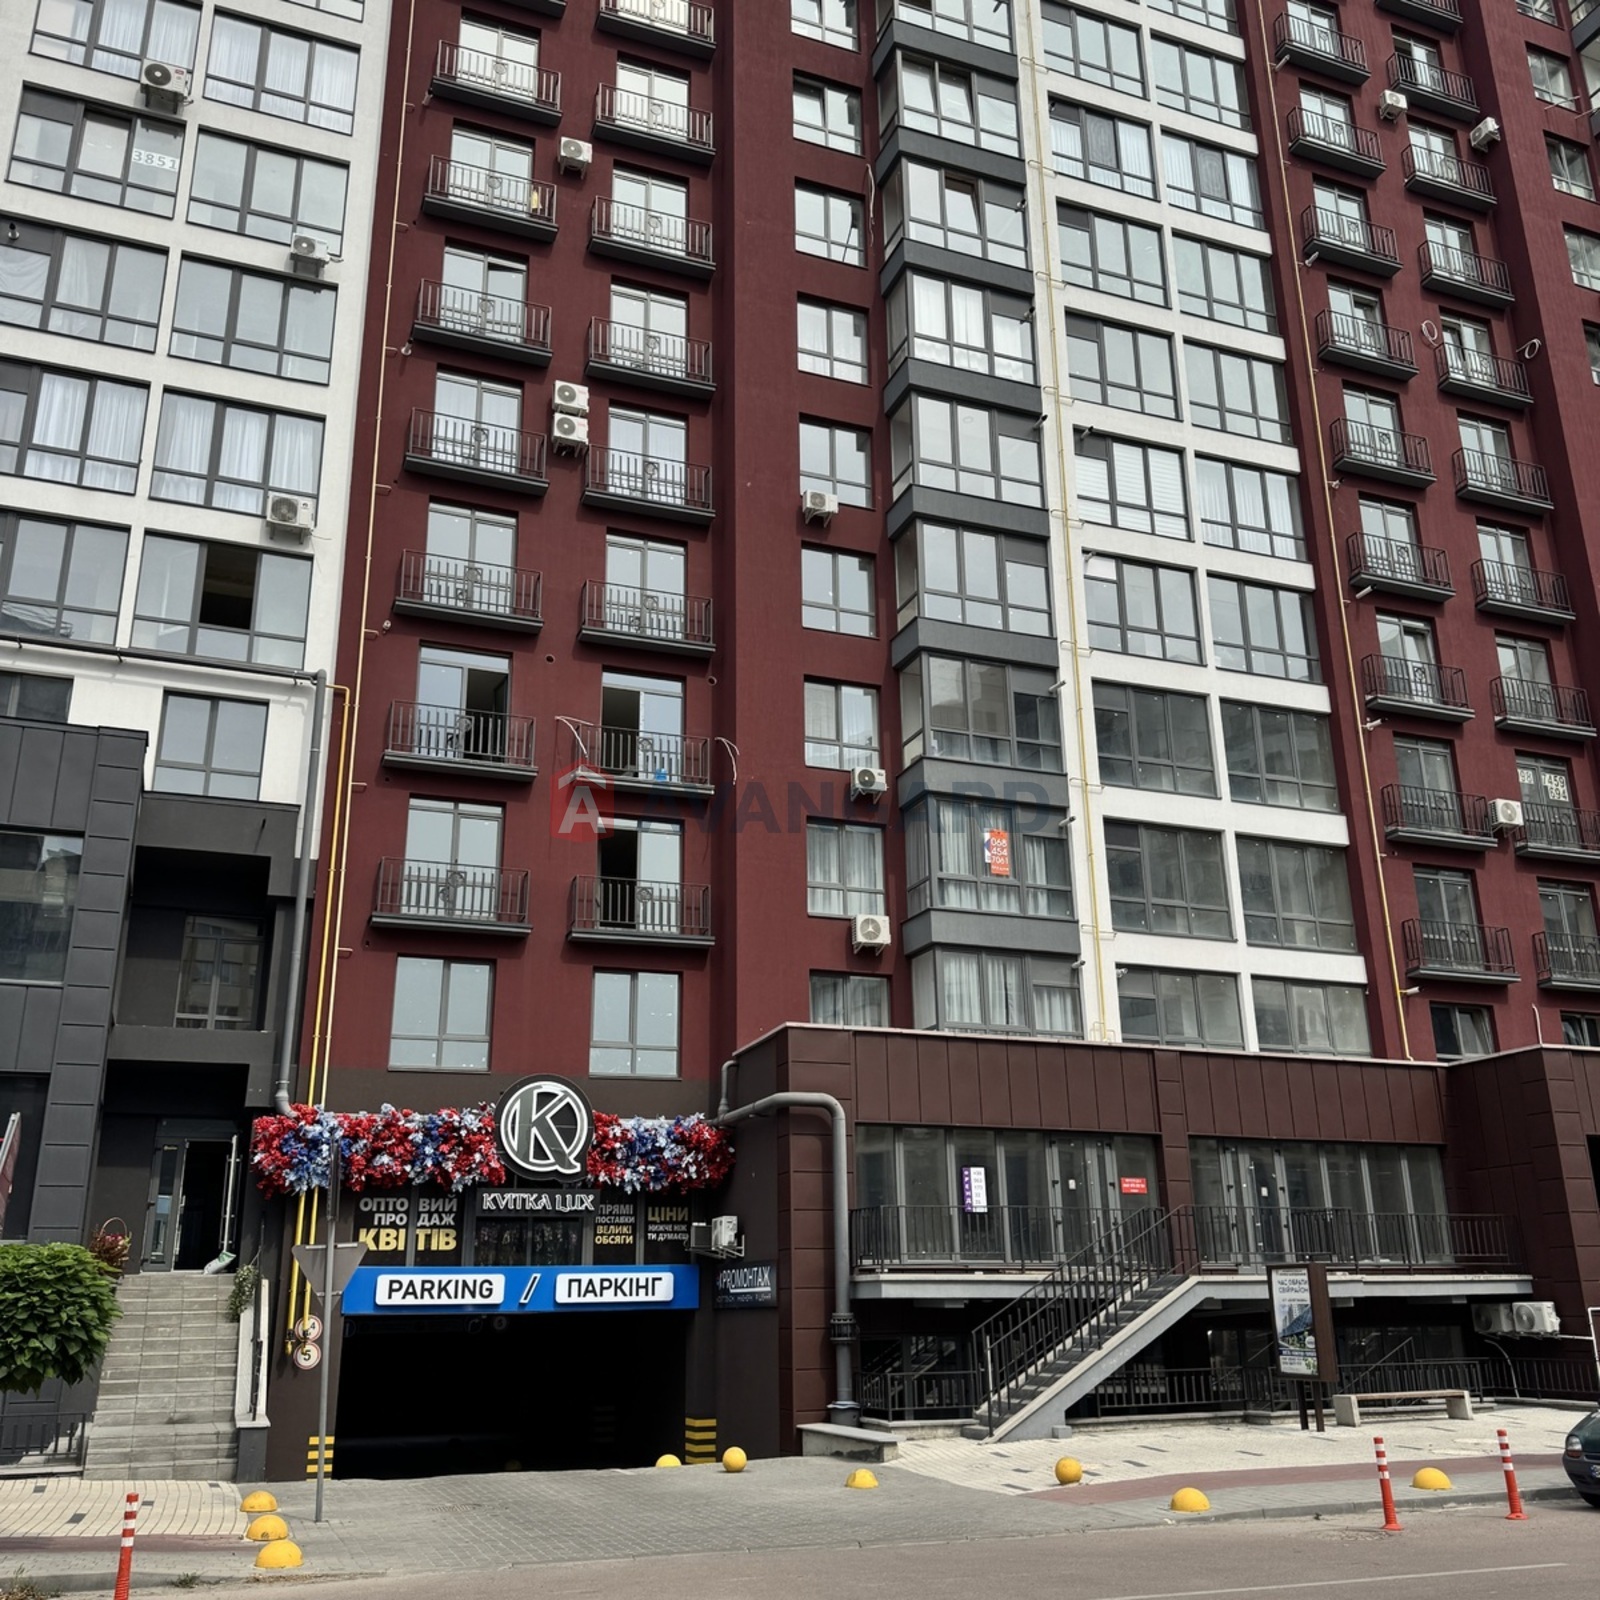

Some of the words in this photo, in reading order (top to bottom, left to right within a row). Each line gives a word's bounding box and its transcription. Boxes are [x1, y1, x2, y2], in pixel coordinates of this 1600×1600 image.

[133, 150, 178, 170] 3851
[1541, 773, 1565, 788] 7459
[1549, 786, 1568, 800] 694
[991, 837, 1008, 847] 068
[482, 1192, 553, 1211] KVITKA
[555, 1194, 596, 1213] LUX
[598, 1204, 634, 1215] ПРЯМІ
[647, 1206, 689, 1223] ЦІНИ
[596, 1225, 632, 1234] ВЕЛИКІ
[594, 1235, 634, 1245] ОБСЯГИ
[388, 1279, 494, 1300] PARKING
[566, 1277, 663, 1299] ПАРКІНГ
[304, 1349, 311, 1361] 5
